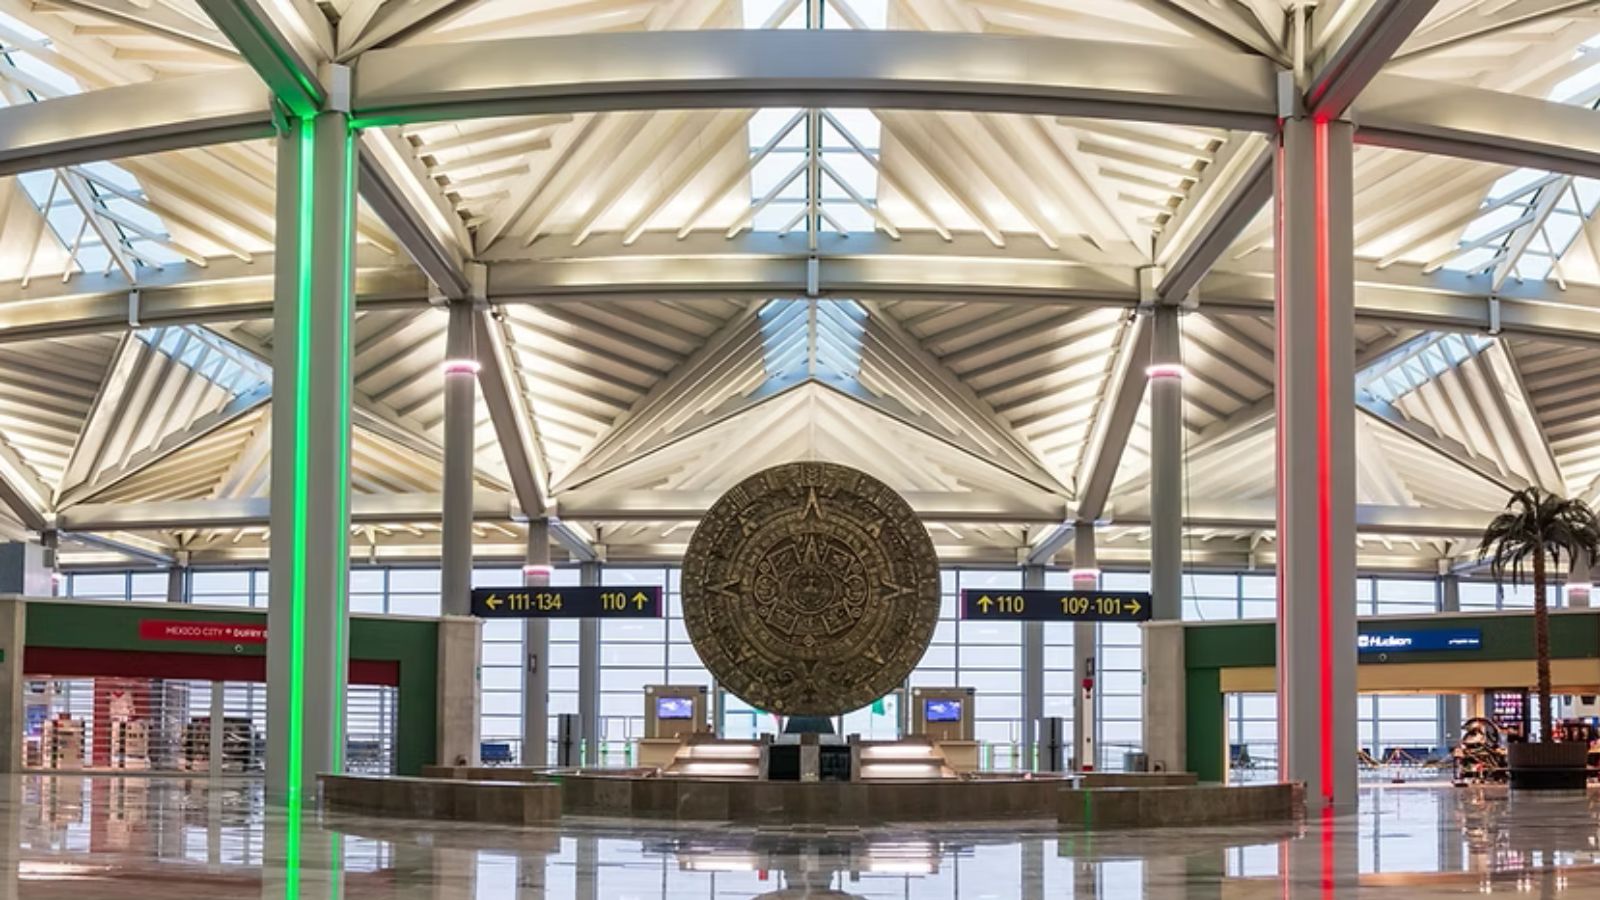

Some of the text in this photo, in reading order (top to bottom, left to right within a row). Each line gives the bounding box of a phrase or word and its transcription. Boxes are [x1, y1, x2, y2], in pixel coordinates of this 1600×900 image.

[508, 593, 562, 610] 111-134
[601, 593, 626, 610] 110
[997, 596, 1024, 613] 110
[1061, 597, 1121, 615] 109-101
[166, 626, 201, 636] MEXICO
[202, 628, 223, 636] CITY
[1370, 636, 1412, 647] Hudson
